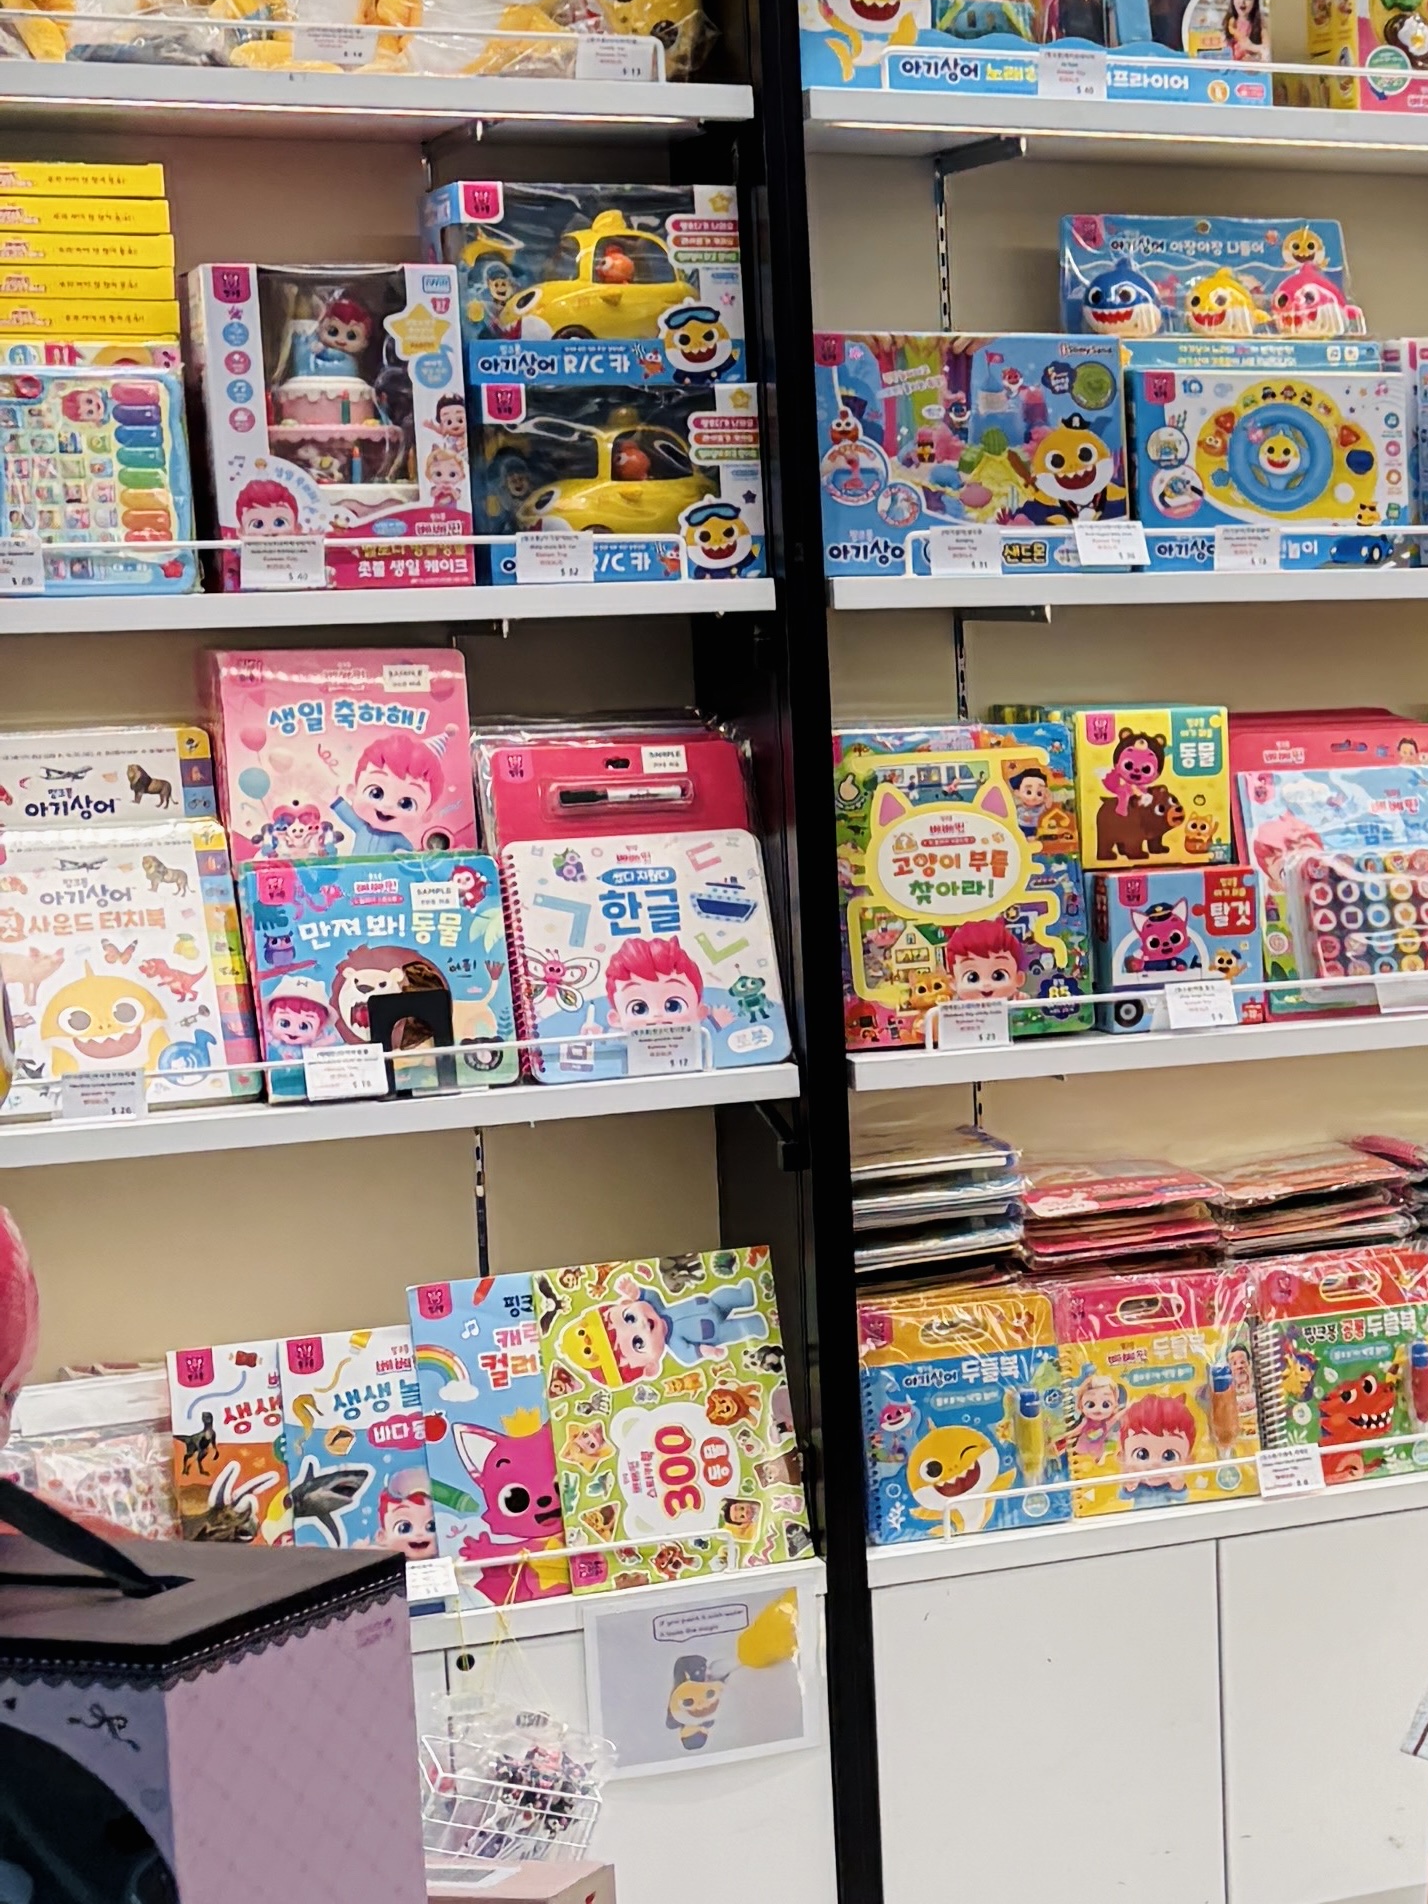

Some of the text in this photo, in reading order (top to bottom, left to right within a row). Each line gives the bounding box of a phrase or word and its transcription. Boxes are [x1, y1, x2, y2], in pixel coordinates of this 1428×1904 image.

[901, 58, 979, 83] 아기상어
[1111, 235, 1165, 256] 아기상어
[480, 355, 630, 377] 아기상어 R/C 카
[389, 559, 421, 578] 생일
[424, 557, 469, 574] 케이크
[632, 552, 651, 572] 카
[270, 699, 430, 736] 생일 축하해!
[1180, 742, 1215, 769] 동물
[25, 794, 117, 821] 아기상어
[892, 853, 961, 878] 고양이
[39, 885, 133, 909] 아기상어
[909, 879, 995, 906] 찾아라!
[27, 907, 167, 937] 사운드 터치북
[598, 888, 682, 937] 한글
[1210, 901, 1251, 929] 탈것
[298, 912, 462, 951] 만져 봐! 동물
[1303, 1322, 1338, 1346] 핑크퐁
[1366, 1309, 1418, 1337] 두들북
[904, 1368, 958, 1389] 아기상어
[333, 1382, 392, 1422] 생생
[654, 1425, 703, 1519] 300
